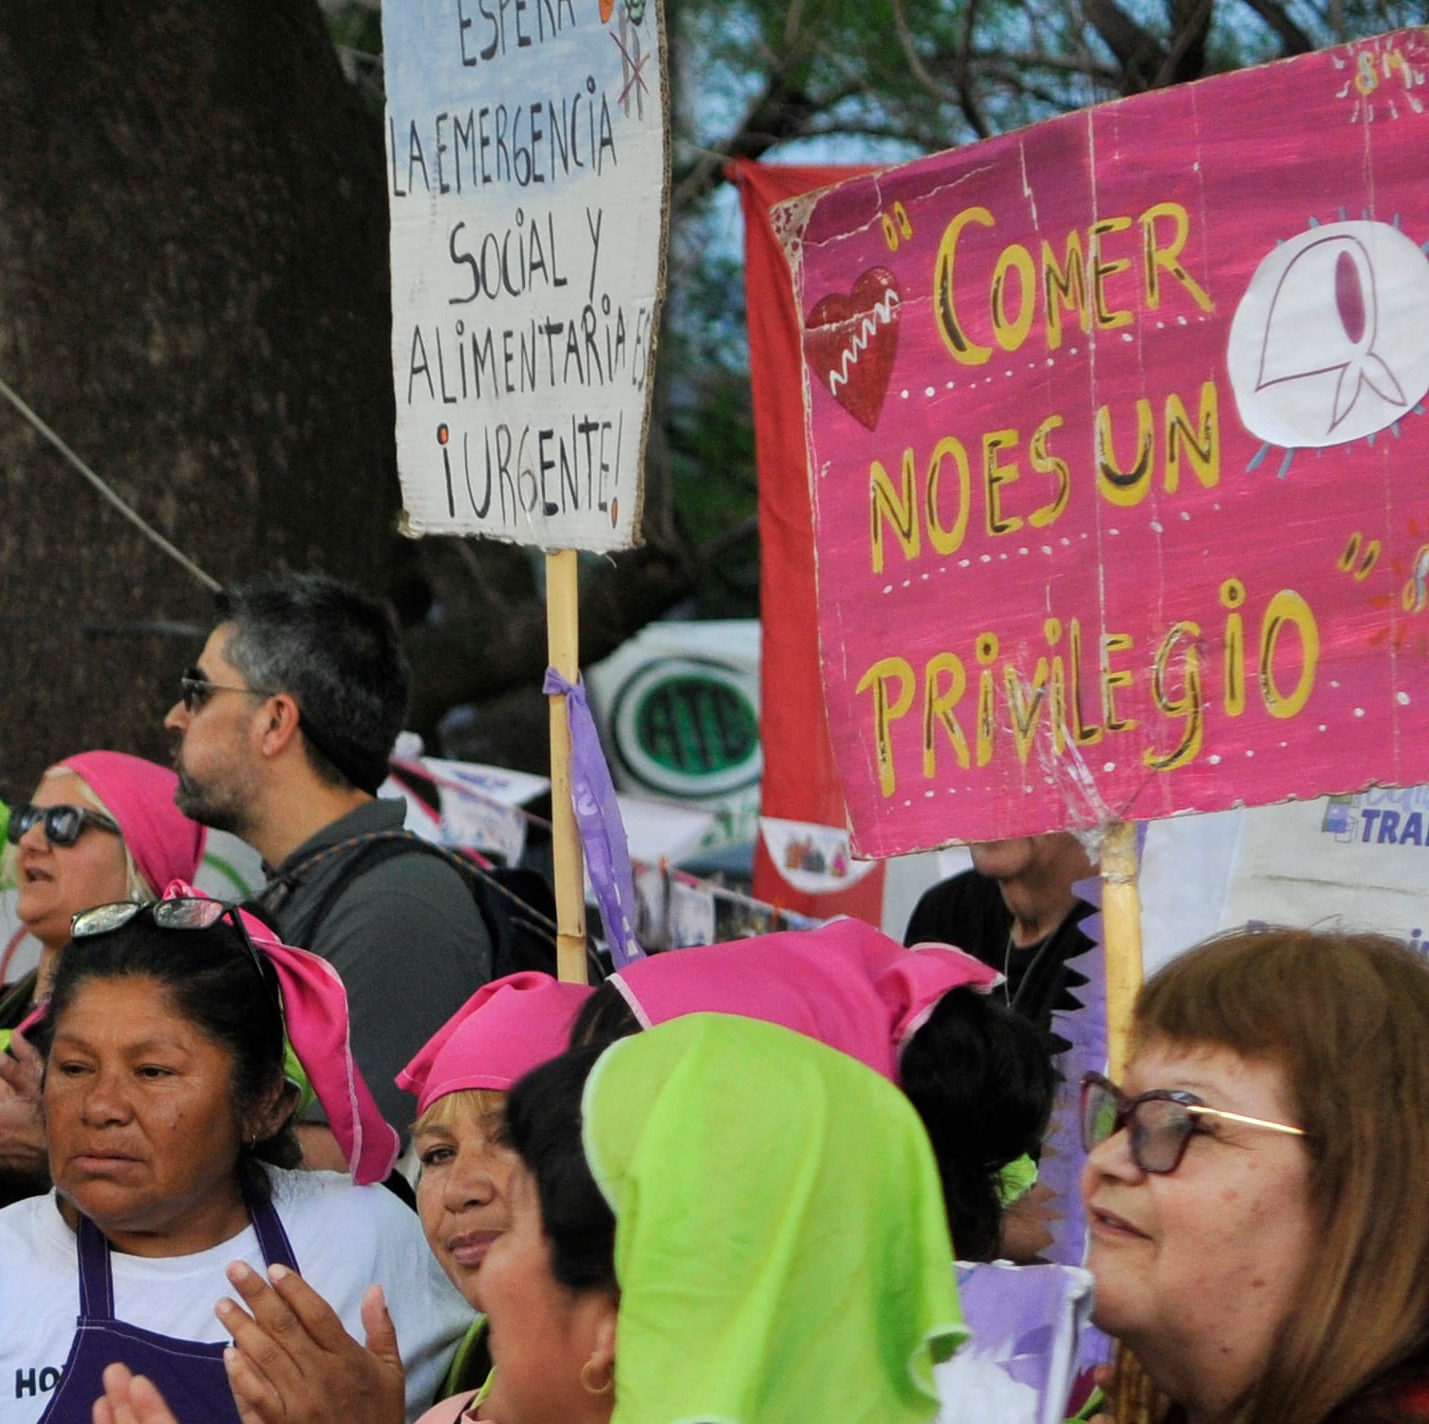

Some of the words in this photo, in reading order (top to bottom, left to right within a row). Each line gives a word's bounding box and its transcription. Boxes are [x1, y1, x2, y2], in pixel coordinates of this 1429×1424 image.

[389, 116, 431, 197] LA
[449, 207, 568, 305] SOCIAL
[585, 206, 604, 304] Y
[1096, 380, 1222, 508] UN
[15, 1366, 67, 1400] HO
